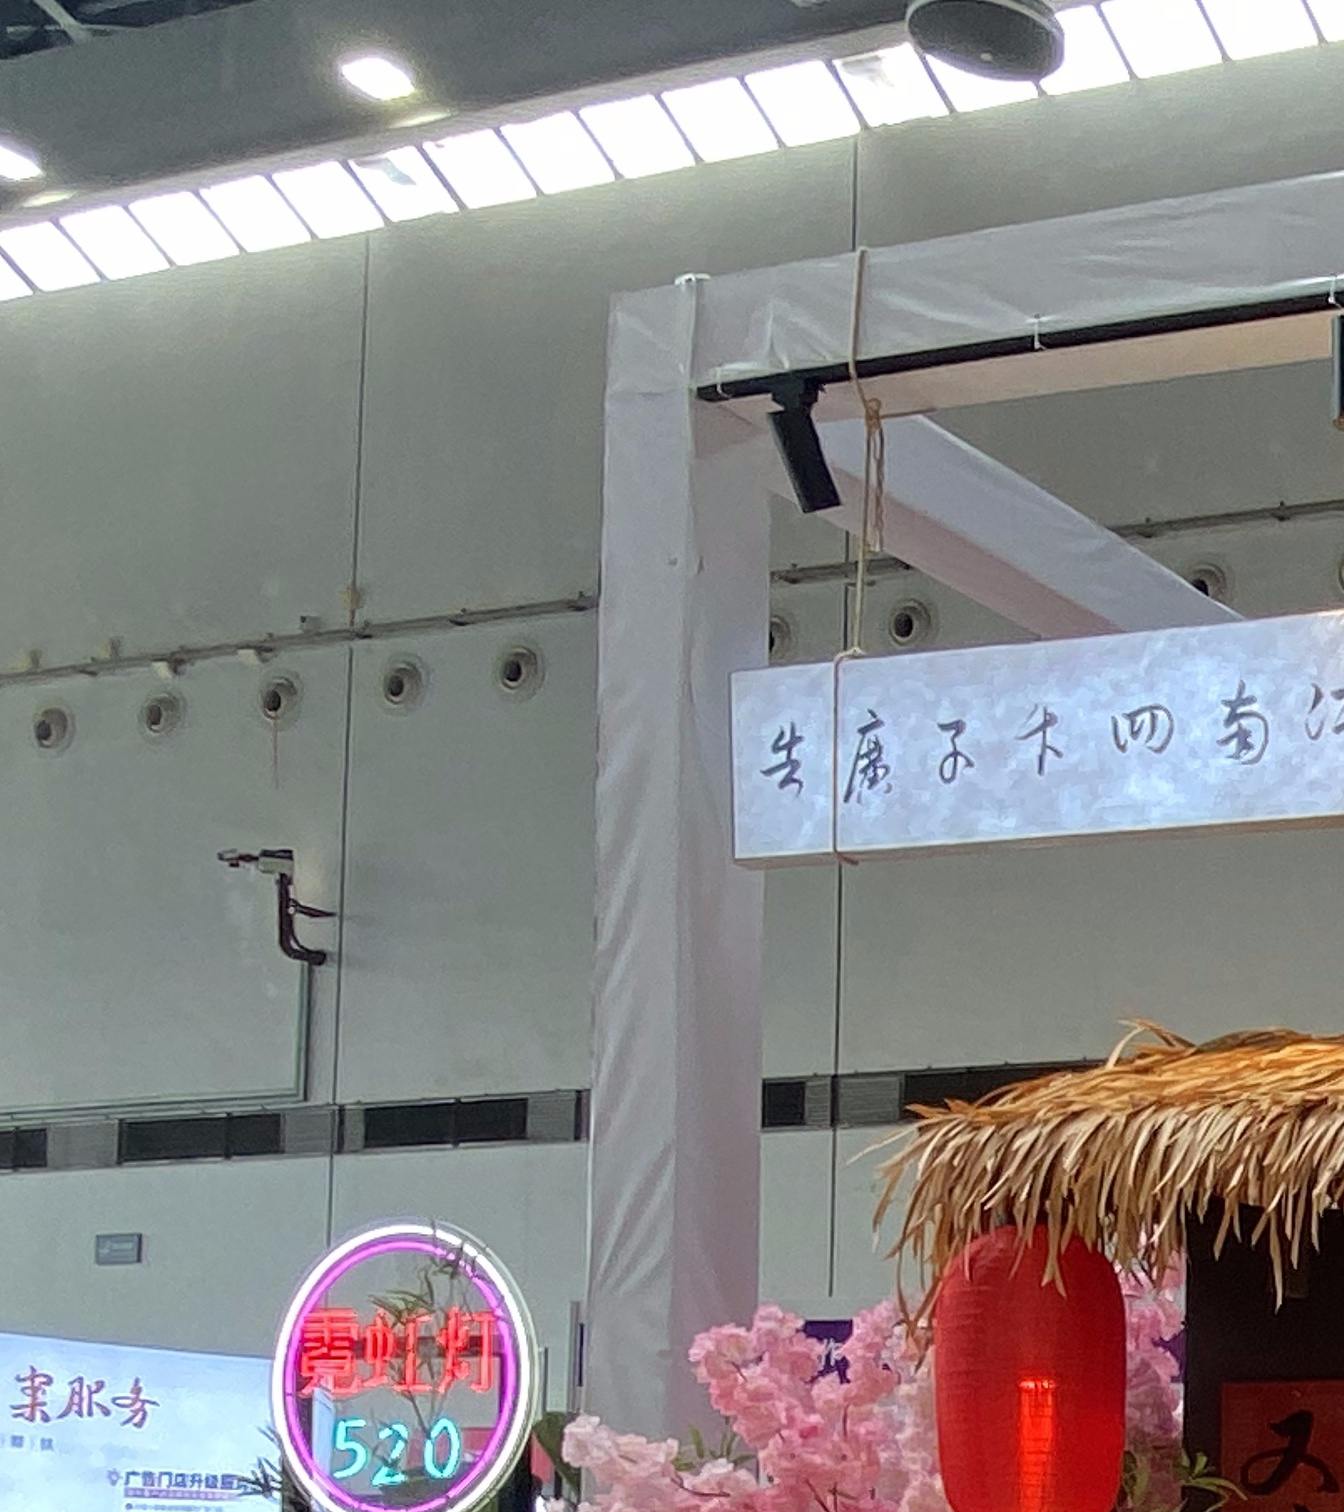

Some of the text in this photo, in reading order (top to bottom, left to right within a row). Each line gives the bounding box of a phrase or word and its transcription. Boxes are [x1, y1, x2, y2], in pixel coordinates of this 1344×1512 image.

[298, 1307, 498, 1398] 霓虹灯
[332, 1416, 462, 1488] 520
